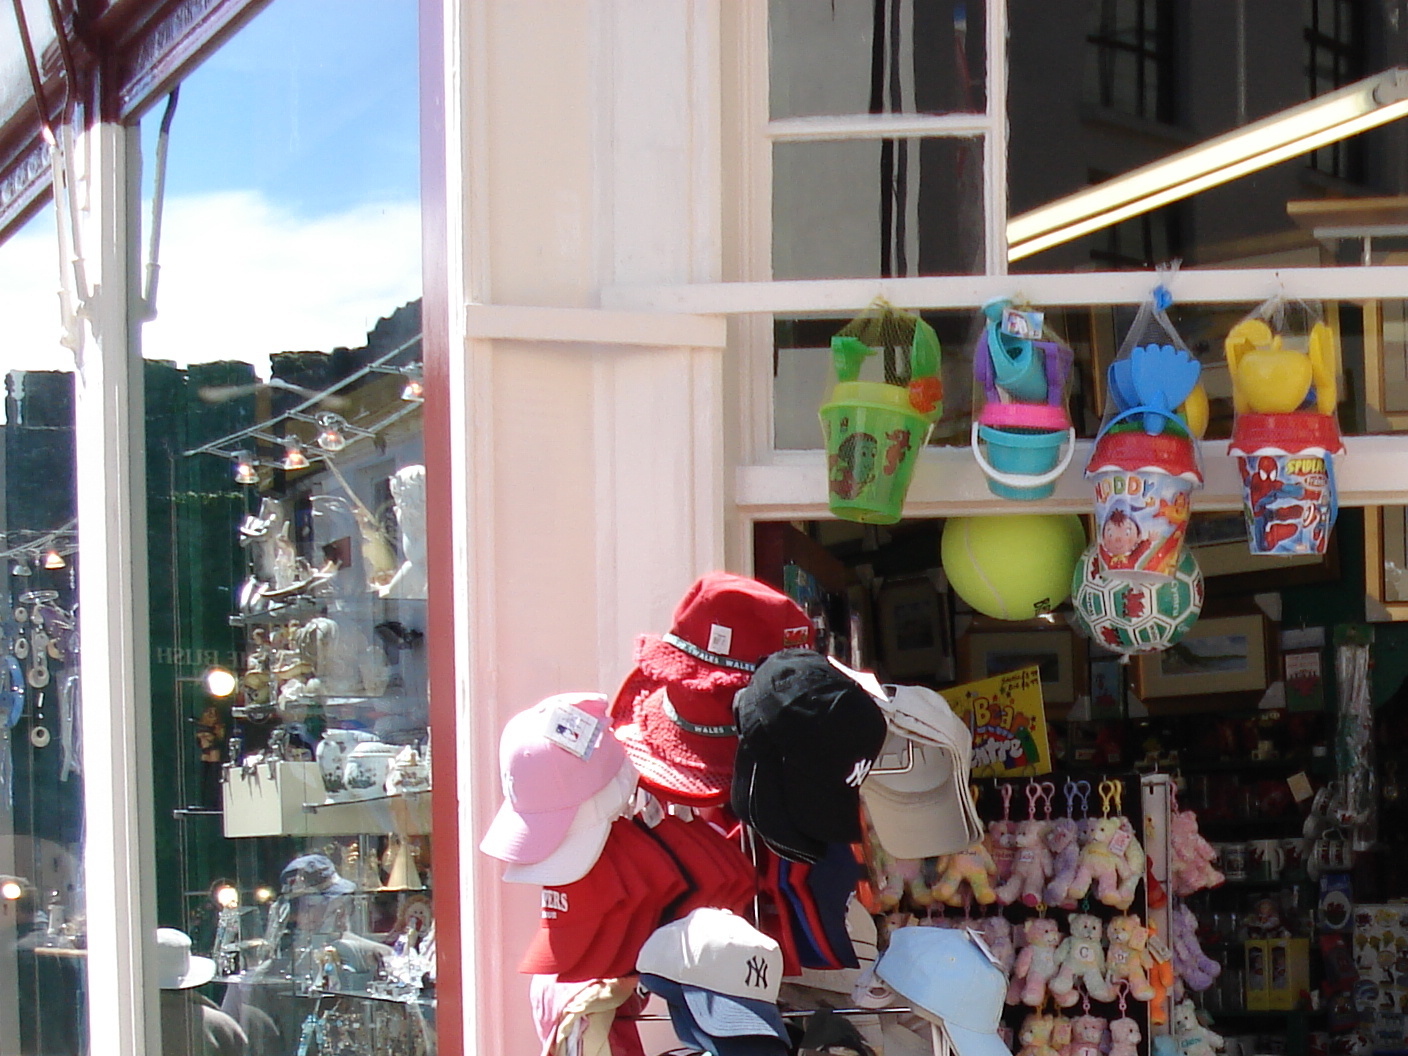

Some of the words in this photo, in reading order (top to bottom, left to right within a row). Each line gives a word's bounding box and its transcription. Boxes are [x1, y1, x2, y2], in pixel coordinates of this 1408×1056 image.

[1095, 474, 1156, 503] NODDY
[724, 659, 756, 673] WALES
[694, 725, 725, 735] WALES
[969, 737, 1024, 768] entre
[744, 954, 768, 990] NY
